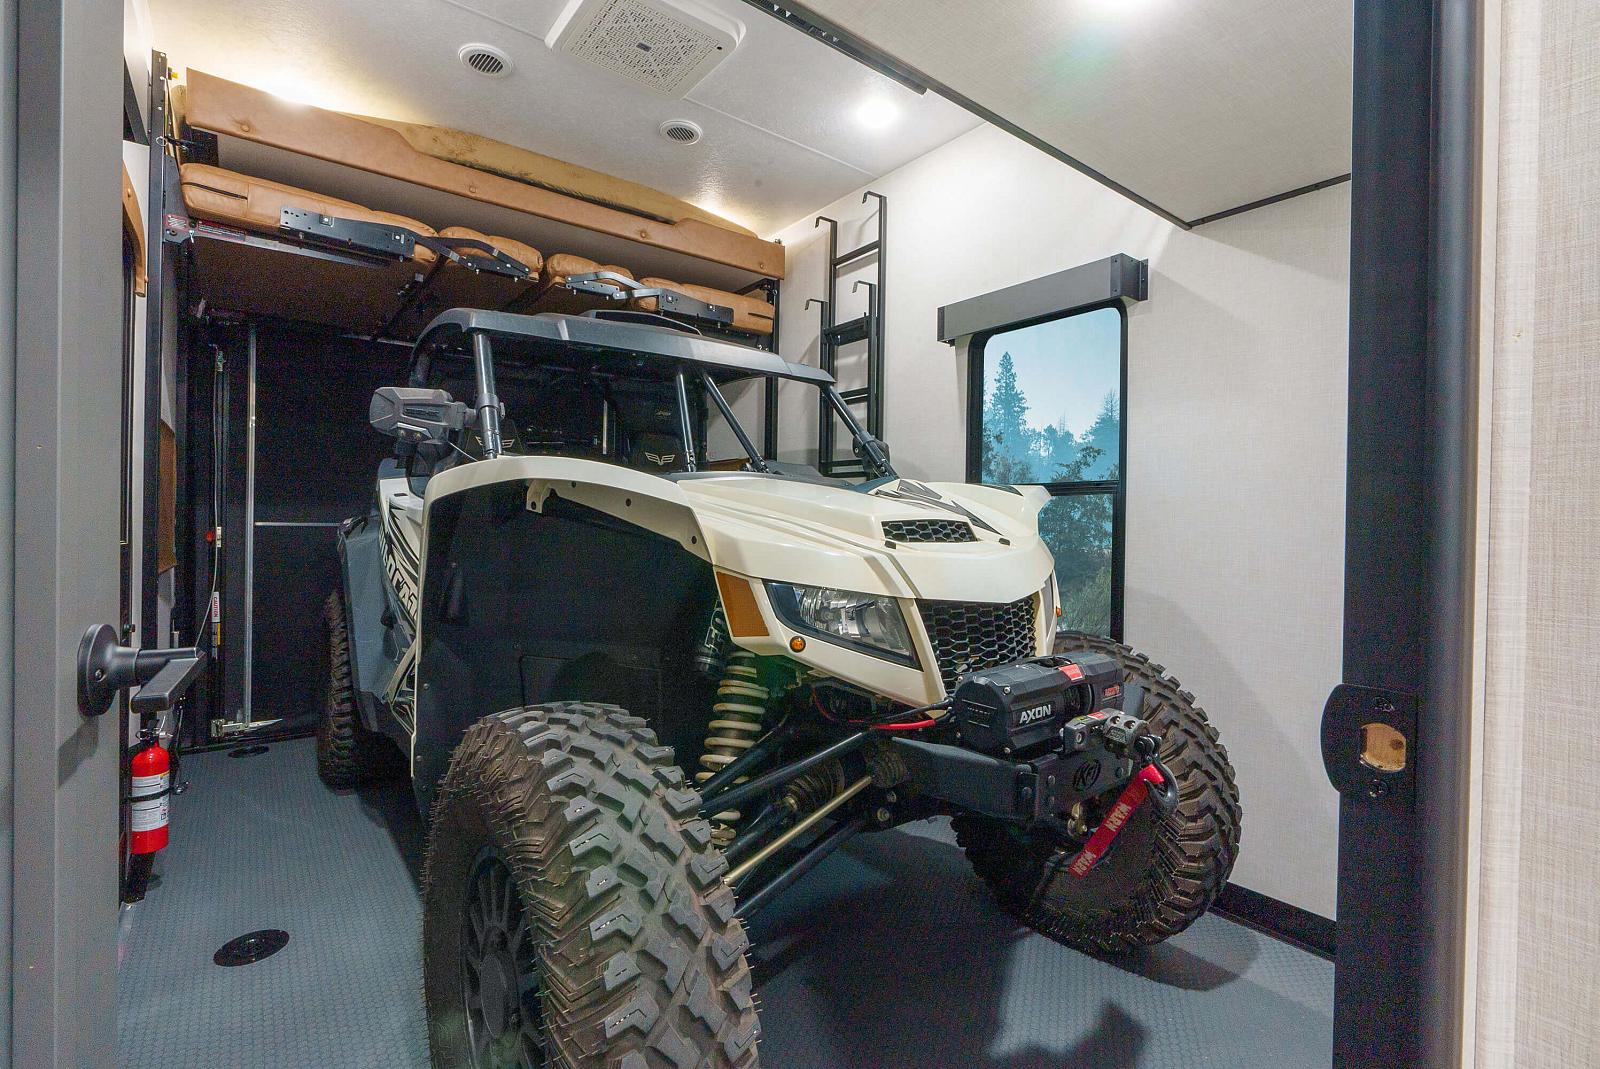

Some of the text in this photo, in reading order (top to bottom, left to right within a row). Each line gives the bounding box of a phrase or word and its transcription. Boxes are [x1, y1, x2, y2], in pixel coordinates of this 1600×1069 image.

[1019, 704, 1051, 724] AXON
[1104, 802, 1132, 832] WARN
[1072, 850, 1097, 876] WARN
